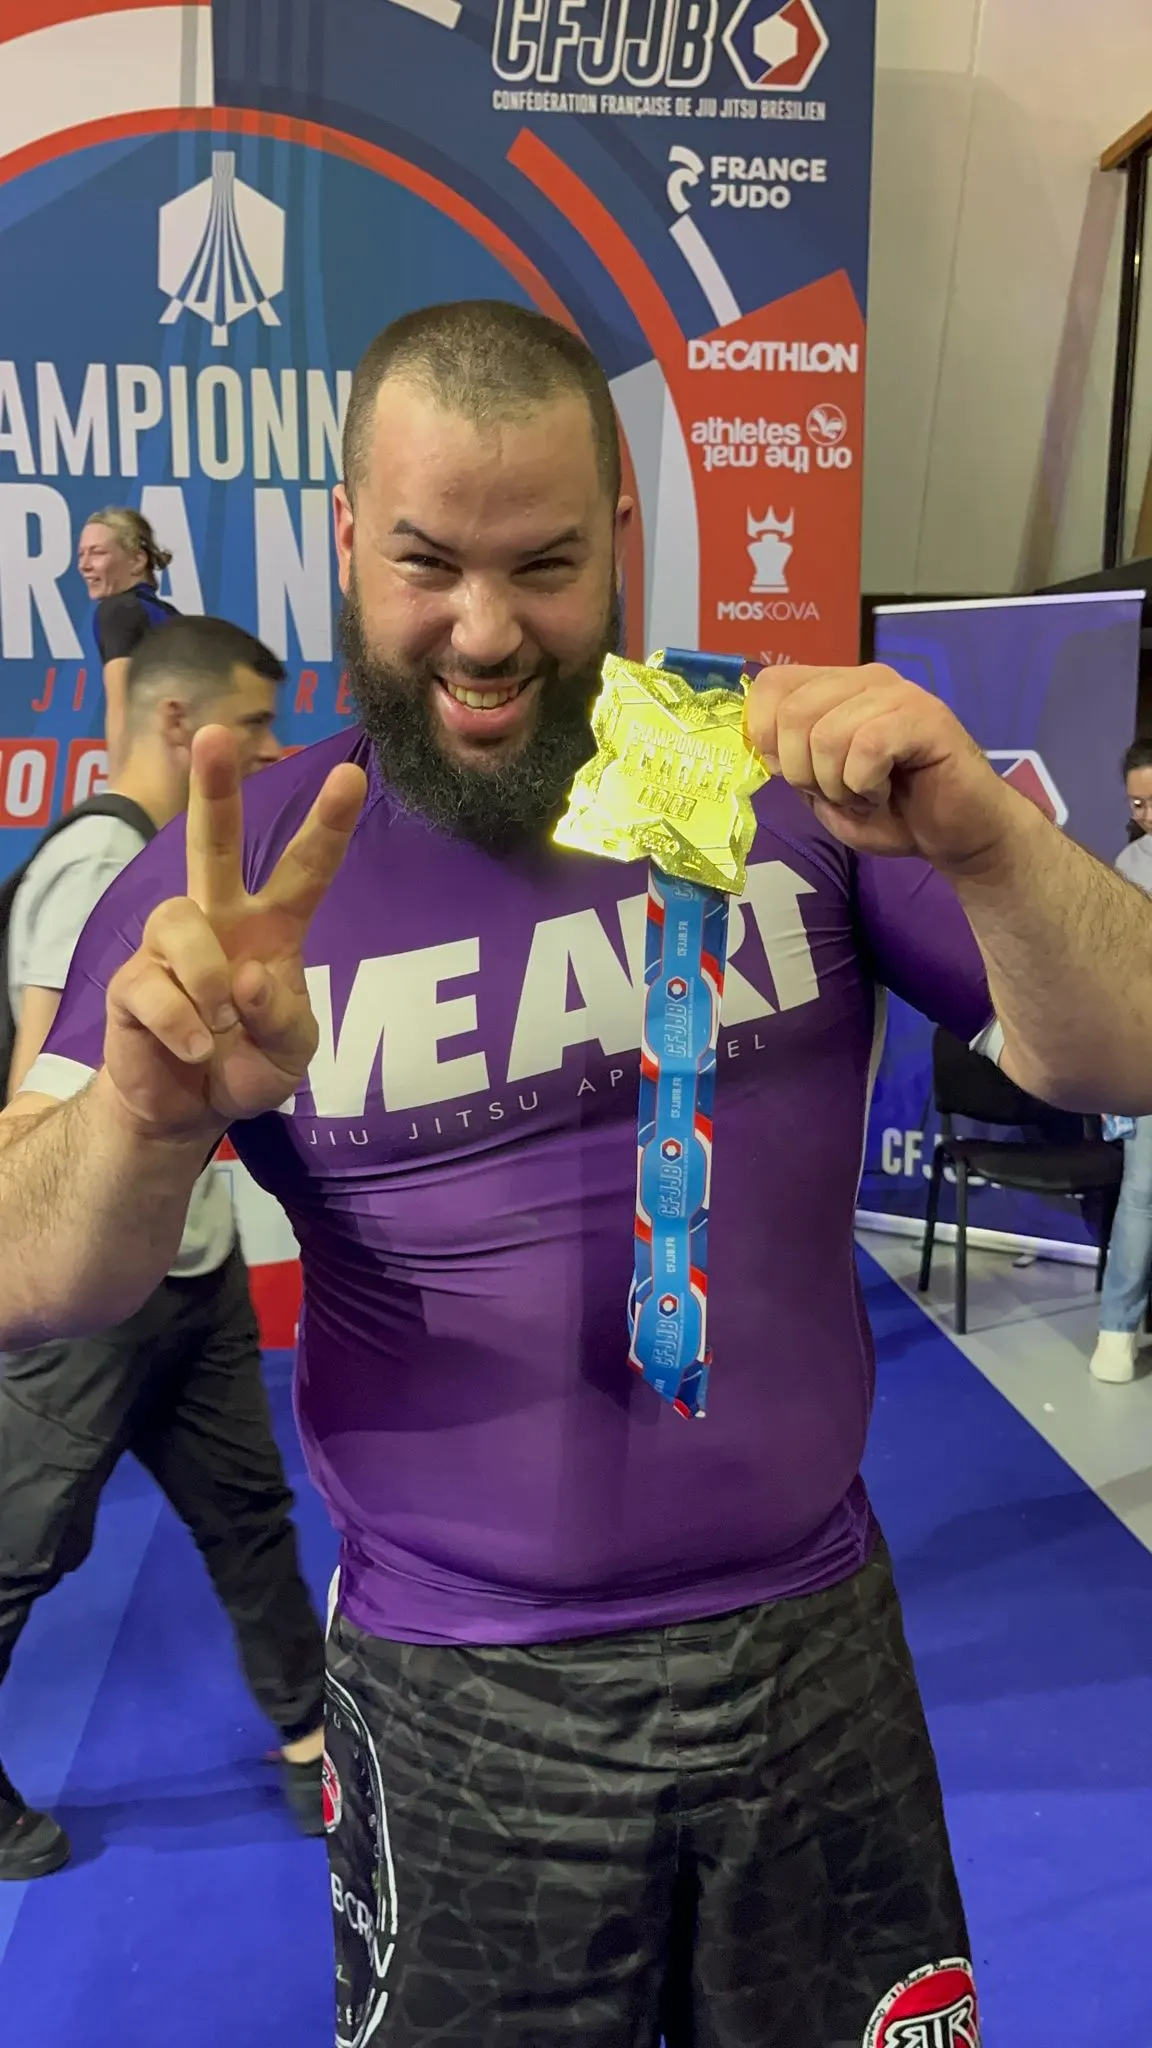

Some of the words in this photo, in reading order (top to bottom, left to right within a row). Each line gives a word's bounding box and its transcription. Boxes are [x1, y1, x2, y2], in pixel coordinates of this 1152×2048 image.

[491, 0, 718, 88] CFJJB
[492, 88, 598, 114] CONFÉDÉRATION
[600, 94, 672, 118] FRANÇAISE
[675, 97, 692, 117] DE
[695, 98, 717, 118] JIU
[719, 98, 758, 119] JITSU
[760, 98, 827, 121] BRÉSILIEN
[711, 156, 827, 182] FRANCE
[710, 185, 791, 209] JUDO
[687, 339, 859, 373] DECATHLON
[691, 416, 801, 445] athletes
[716, 601, 820, 621] MOSKOVA
[309, 1129, 370, 1146] JIU
[408, 1091, 540, 1140] JITSU
